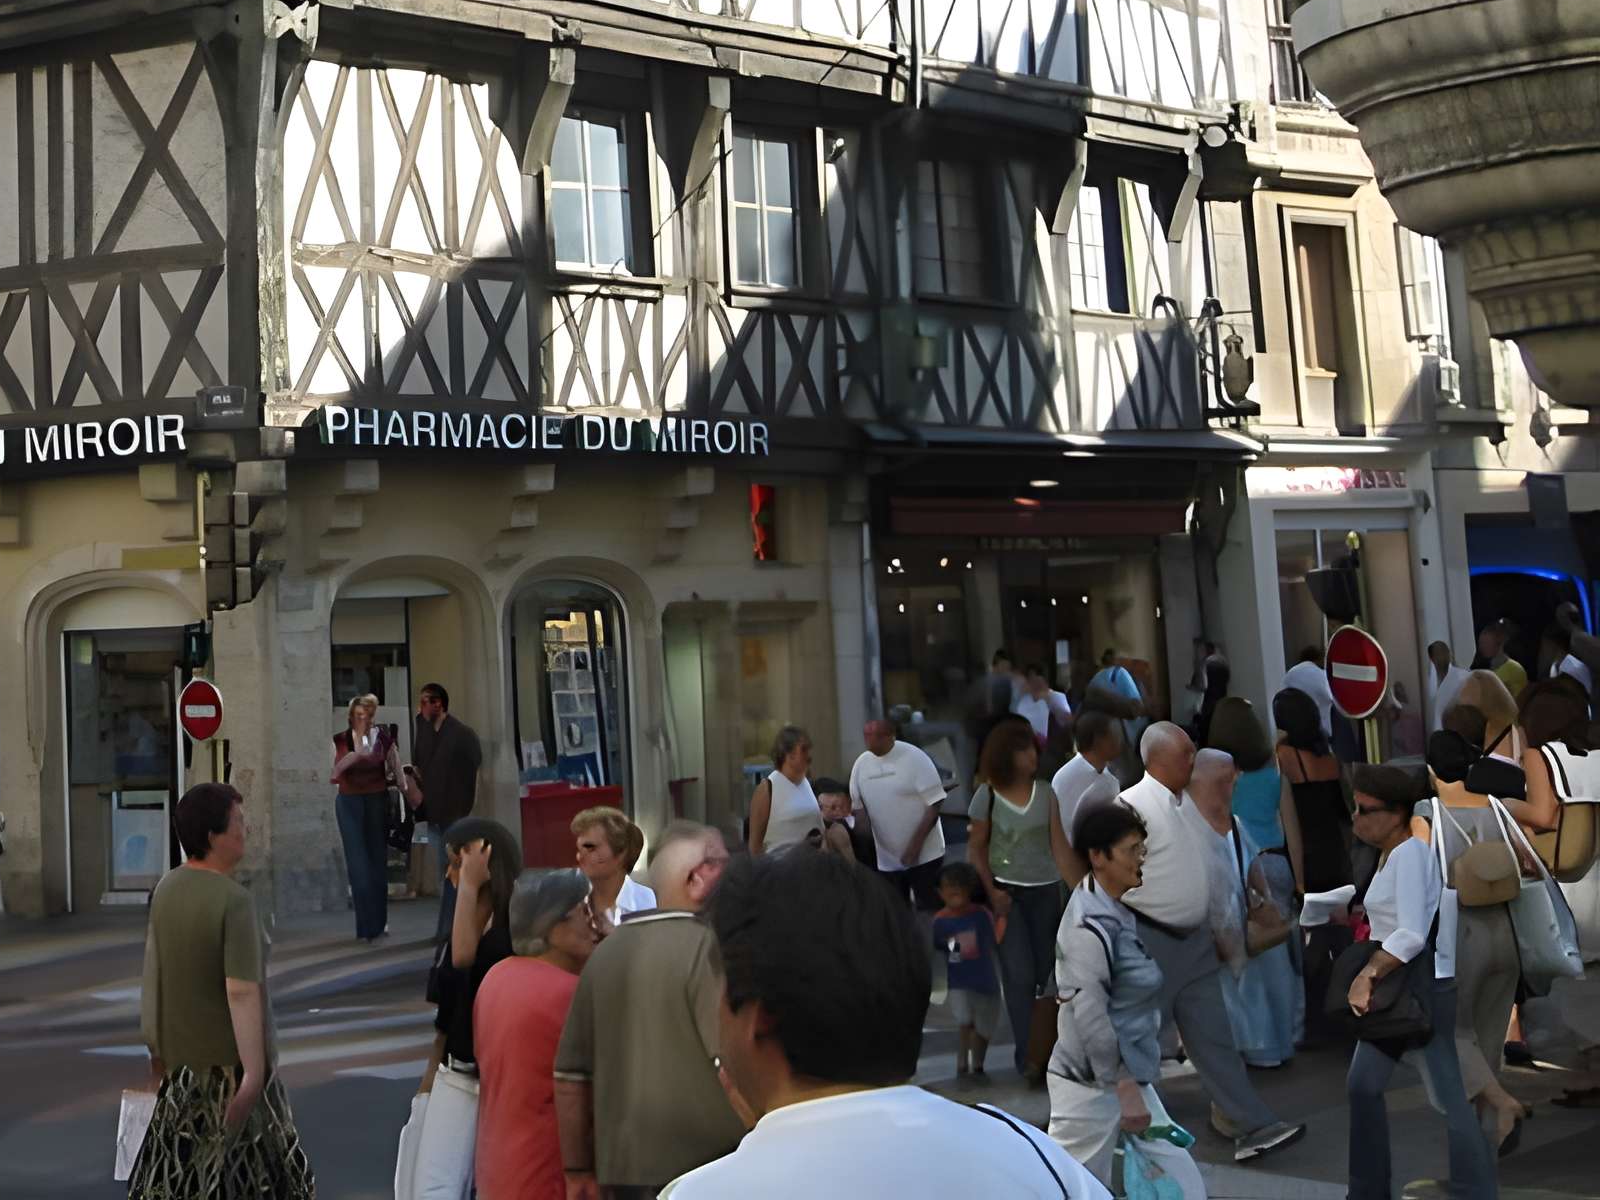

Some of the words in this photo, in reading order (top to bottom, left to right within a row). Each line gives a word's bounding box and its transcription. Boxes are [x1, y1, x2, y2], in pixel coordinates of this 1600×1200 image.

[24, 414, 186, 464] MIROIR
[325, 405, 564, 450] PHARMACIE
[582, 415, 632, 452] DU
